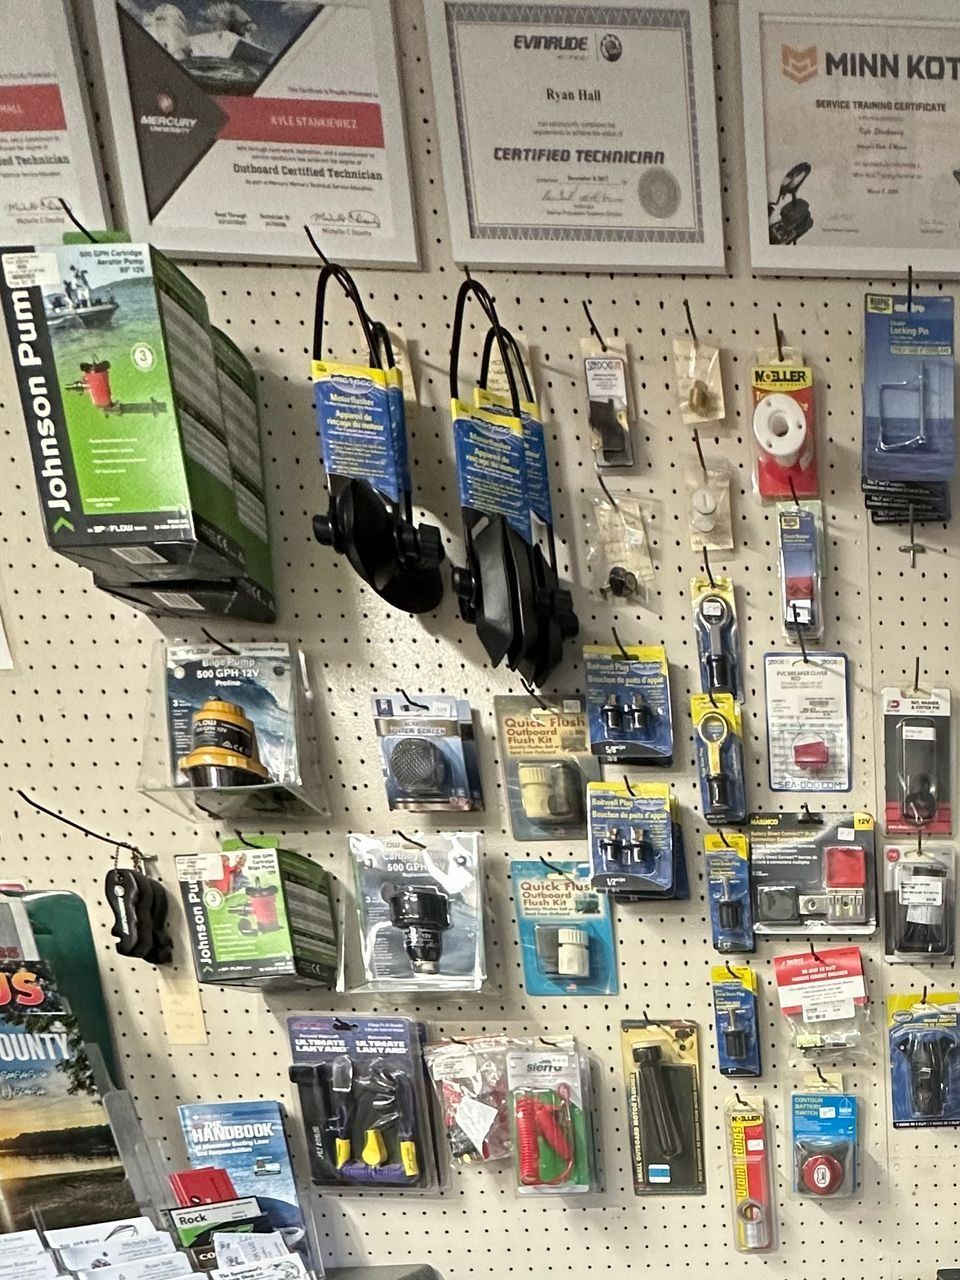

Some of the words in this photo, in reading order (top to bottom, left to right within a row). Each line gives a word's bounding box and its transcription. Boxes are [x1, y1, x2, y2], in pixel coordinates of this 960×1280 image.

[513, 35, 588, 50] EVINRUDE
[825, 52, 898, 78] MINN
[546, 88, 576, 103] Ryan
[578, 89, 601, 102] Hall
[815, 99, 850, 110] SERVICE
[852, 101, 893, 111] TRAINING
[894, 103, 947, 113] CERTIFICATE
[141, 115, 198, 128] MERCURY
[493, 147, 571, 162] CERTIFIED
[575, 149, 665, 165] TECHNICIAN
[233, 163, 279, 175] Outboard
[281, 164, 325, 177] Certified
[326, 166, 383, 181] Technician
[889, 326, 917, 337] Locking
[918, 327, 930, 336] Pin
[139, 349, 148, 361] 3
[28, 376, 71, 513] Johnson
[196, 669, 214, 679] 500
[215, 668, 239, 678] GPH
[241, 668, 260, 678] 12V
[506, 728, 558, 737] Outboard
[507, 736, 536, 746] Flush
[537, 736, 553, 745] Kit
[857, 818, 871, 826] 12V
[387, 862, 404, 872] 500
[522, 891, 572, 900] Outboard
[523, 899, 551, 908] Flush
[552, 899, 567, 907] Kit
[193, 906, 212, 965] Johnson
[295, 1038, 346, 1047] ULTIMATE
[356, 1040, 406, 1049] ULTIMATE
[295, 1045, 346, 1055] LANYARD
[526, 1061, 563, 1073] sierra
[192, 1122, 275, 1143] HANDBOOK
[178, 1213, 208, 1226] Rock
